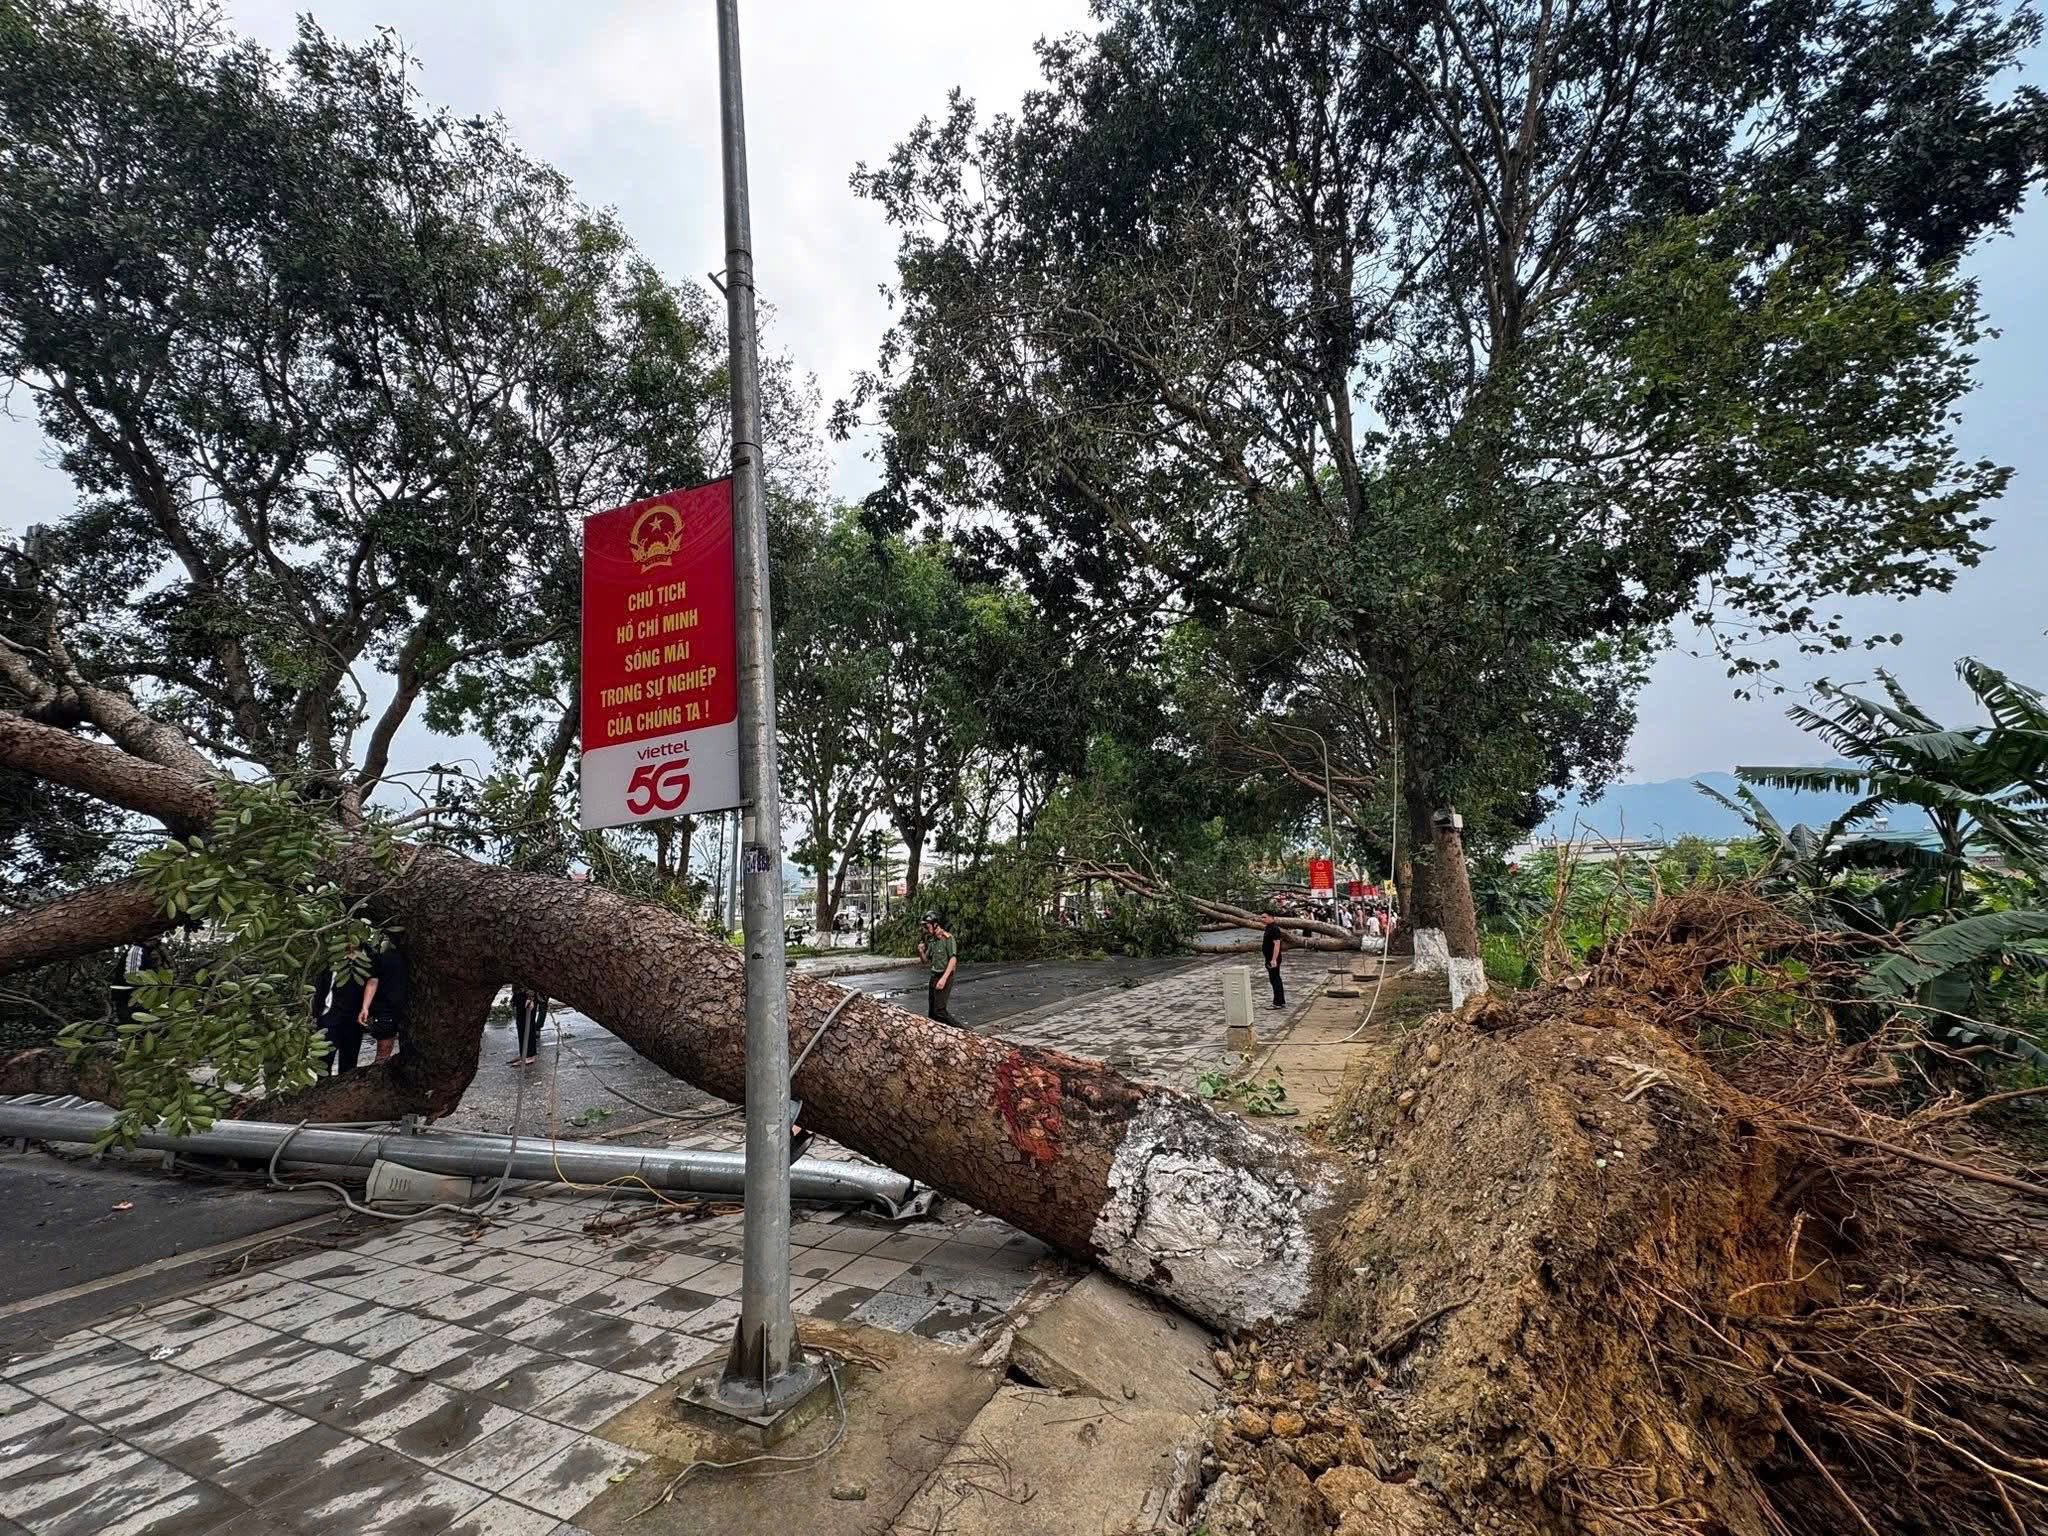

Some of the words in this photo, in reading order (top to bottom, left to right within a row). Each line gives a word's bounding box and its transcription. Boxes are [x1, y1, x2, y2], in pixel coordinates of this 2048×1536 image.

[628, 584, 653, 611] CHỦ
[657, 581, 686, 606] TỊCH
[616, 618, 633, 644] HỒ
[638, 614, 659, 639] CHÍ
[663, 608, 698, 633] MINH
[624, 646, 660, 672] SỐNG
[664, 639, 690, 664] MÃI
[600, 683, 642, 708] TRONG
[646, 676, 664, 700] SỰ
[668, 665, 717, 694] NGHIỆP
[607, 712, 633, 737] CỦA
[637, 705, 681, 731] CHÚNG
[686, 702, 700, 721] TA
[637, 740, 690, 760] viettel
[626, 758, 691, 815] 5G
